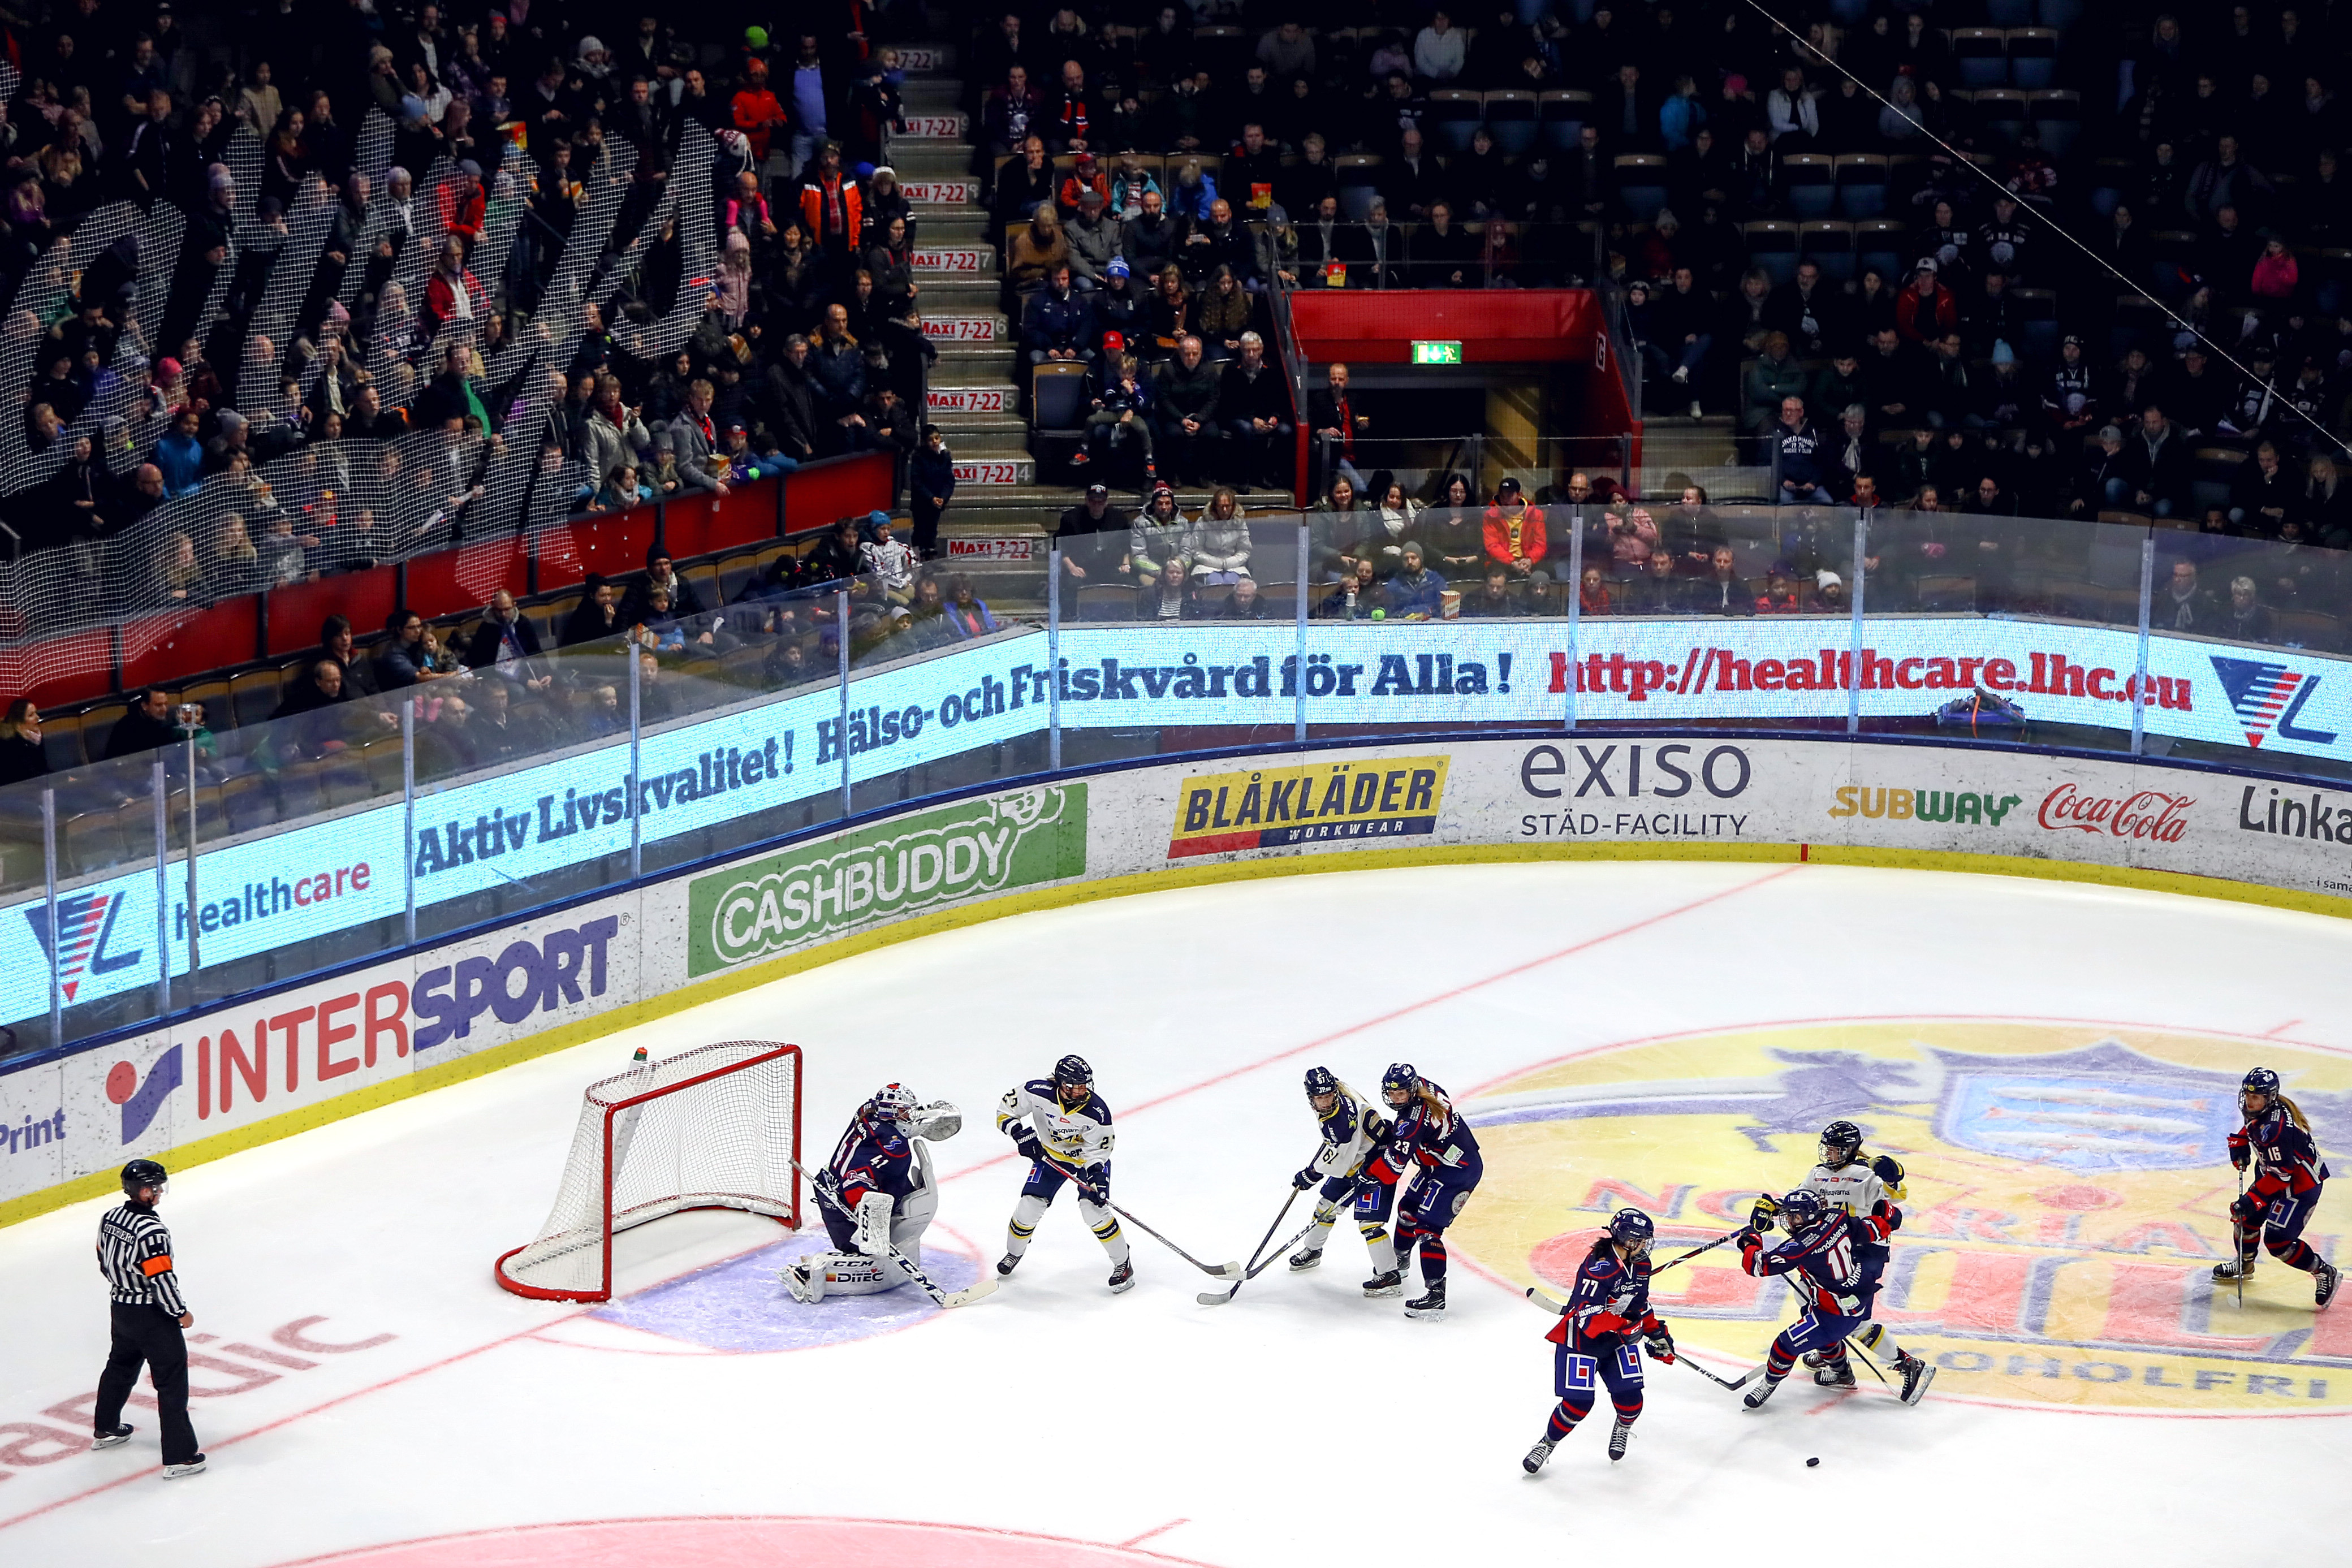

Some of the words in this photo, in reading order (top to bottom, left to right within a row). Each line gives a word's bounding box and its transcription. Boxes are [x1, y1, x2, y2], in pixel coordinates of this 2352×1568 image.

[901, 53, 931, 68] 7-22
[925, 119, 956, 136] 7-22
[933, 185, 964, 202] 7-22
[945, 253, 976, 269] 7-22
[981, 252, 991, 267] 7
[960, 322, 991, 339] 7-22
[995, 319, 1006, 334] 6
[969, 394, 1001, 410] 7-22
[1004, 392, 1015, 407] 5
[953, 466, 977, 478] AXI
[981, 466, 1013, 482] 7-22
[1018, 465, 1030, 481] 4
[996, 541, 1029, 559] 7-22
[415, 807, 531, 877] Aktiv
[1010, 652, 1271, 710] Friskvård
[1280, 654, 1364, 697] för
[1371, 653, 1512, 696] Alla!
[1548, 647, 2193, 712] http://healthcare.lhc.eu
[1184, 764, 1438, 832] BLÅKLÄDER
[1827, 785, 2023, 827] SUBWAY
[2038, 783, 2198, 843] Coca-Cola
[2239, 785, 2352, 845] Linka
[1289, 820, 1405, 841] WORKWEAR
[1521, 808, 1748, 837] STÄD-FACILITY
[723, 827, 1011, 949] CASHBUDDY
[175, 861, 371, 941] healthcare
[197, 914, 618, 1121] INTERSPORT
[1394, 1140, 1410, 1155] 23
[2268, 1147, 2282, 1161] 16
[870, 1154, 889, 1169] 41
[1811, 1223, 1848, 1255] Handelsbanke
[1828, 1236, 1855, 1280] 10
[1580, 1278, 1599, 1297] 77
[1697, 1367, 1717, 1381] CCM
[1762, 1346, 2329, 1400] OHOLFRI
